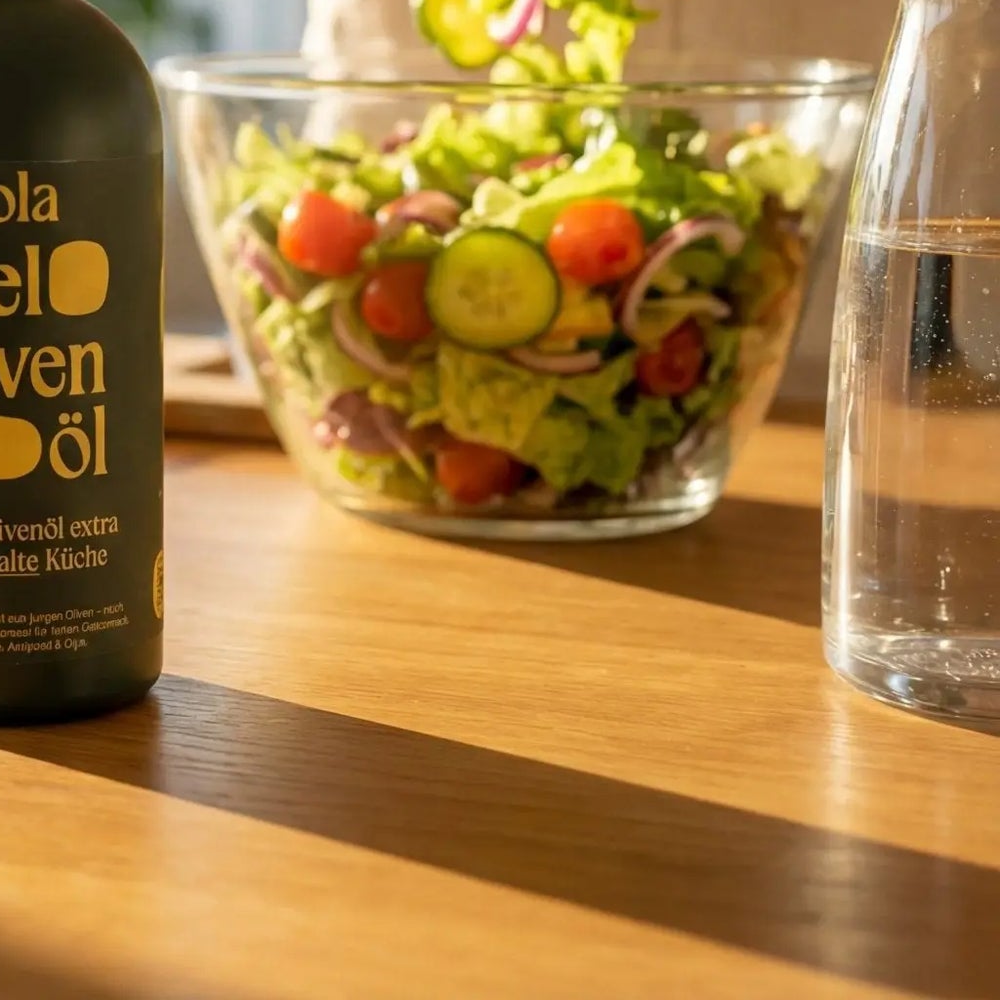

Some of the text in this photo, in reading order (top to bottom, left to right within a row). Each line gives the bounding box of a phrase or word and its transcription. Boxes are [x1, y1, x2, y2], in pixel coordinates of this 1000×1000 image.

[50, 404, 108, 479] öl
[70, 515, 119, 538] extra
[45, 544, 108, 571] Küche
